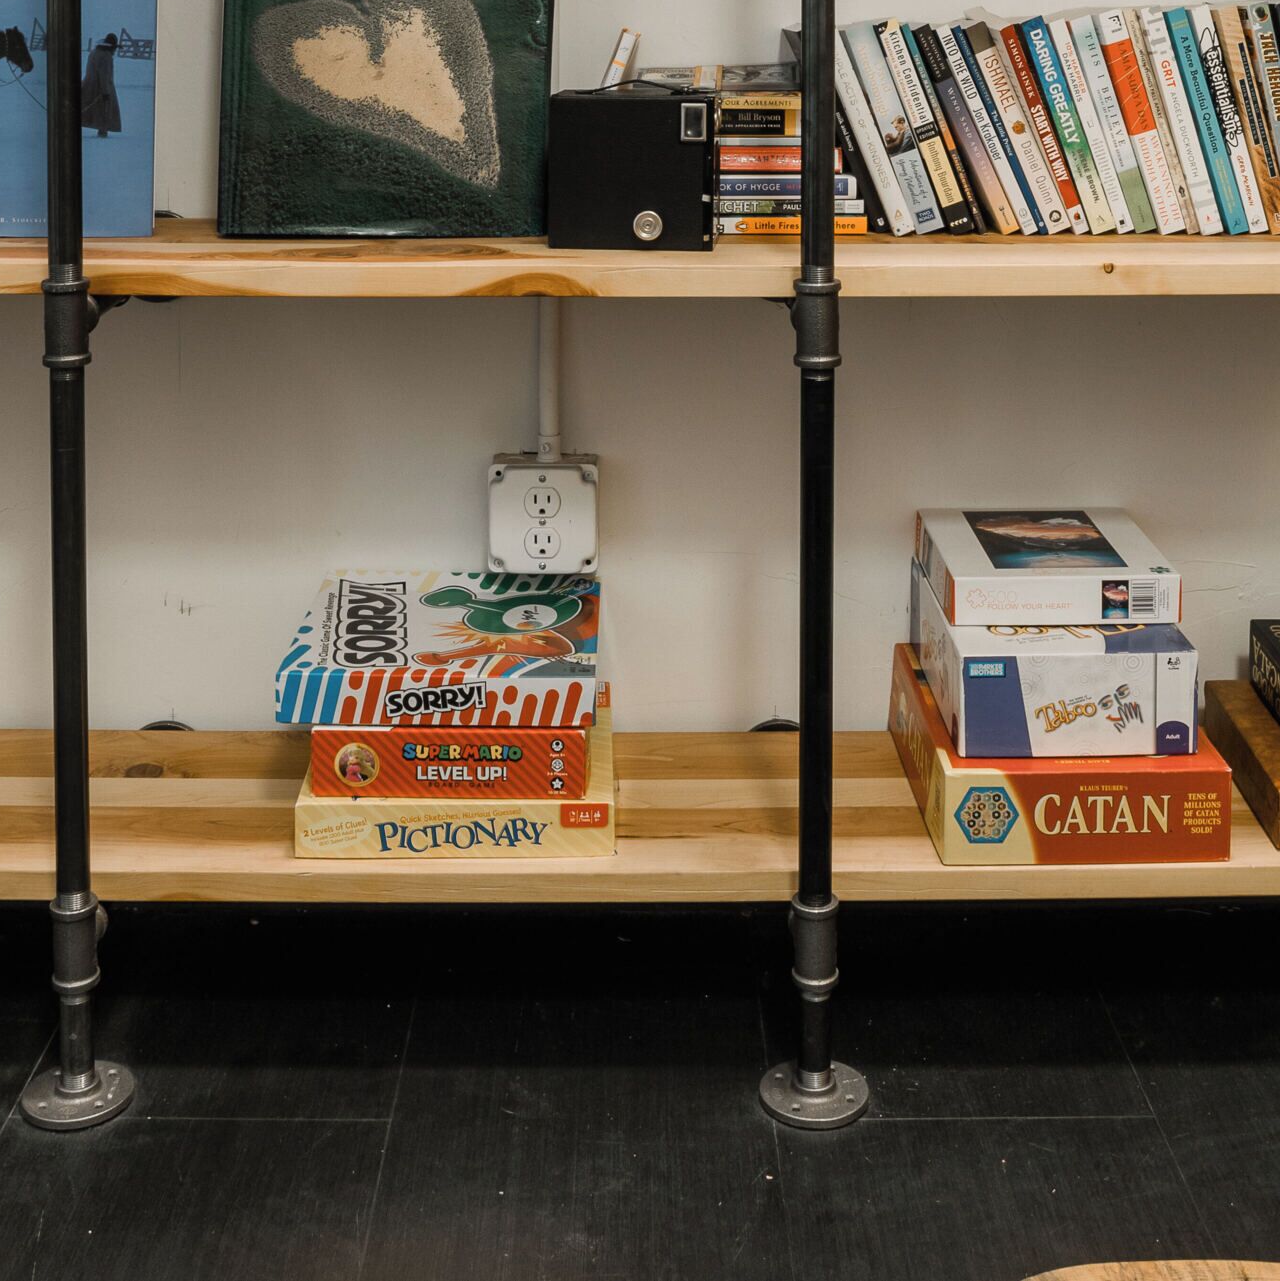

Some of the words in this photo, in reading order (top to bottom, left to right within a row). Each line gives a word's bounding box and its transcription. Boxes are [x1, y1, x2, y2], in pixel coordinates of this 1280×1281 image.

[942, 34, 959, 57] INTO
[1180, 35, 1189, 43] A
[952, 57, 968, 76] THE
[1008, 38, 1025, 69] SIMON
[1020, 70, 1036, 98] SINEK
[1183, 45, 1194, 68] More
[889, 31, 907, 66] Kitchen
[902, 67, 930, 124] Confidential
[959, 75, 978, 100] WILD
[983, 53, 1017, 114] ISHMAEL
[1029, 28, 1058, 82] DARING
[1049, 83, 1081, 143] GREATLY
[1190, 70, 1208, 110] Beautiful
[1206, 51, 1238, 134] essentialism
[738, 113, 751, 121] Bill
[753, 113, 781, 122] Bryson
[972, 107, 986, 122] Jon
[1161, 59, 1177, 88] GRIT
[1170, 91, 1185, 127] ANGELA
[1180, 126, 1199, 178] DUCKWORTH
[980, 122, 1002, 161] Krakauer
[1030, 104, 1050, 134] START
[1041, 134, 1061, 160] WITH
[1051, 158, 1069, 182] WHY
[1202, 112, 1218, 154] Question
[927, 141, 942, 172] Anthony
[939, 170, 956, 203] Bourdain
[1020, 140, 1042, 173] Daniel
[1035, 174, 1054, 205] Quinn
[1138, 137, 1159, 181] BUDDHA
[1152, 184, 1169, 226] WITHIN
[754, 221, 776, 231] Little
[778, 221, 799, 230] Fires
[987, 603, 1019, 611] FOLLOW
[343, 584, 399, 665] SORRY!
[387, 684, 485, 716] SORRY!
[1035, 700, 1098, 732] Taboo
[403, 743, 461, 761] SUPER
[462, 744, 522, 762] MARIO
[417, 765, 473, 781] LEVEL
[477, 765, 507, 781] UP!
[1183, 801, 1221, 809] MILLIONS
[1187, 793, 1203, 801] TENS
[1206, 793, 1218, 801] OF
[303, 830, 309, 838] 2
[310, 825, 335, 837] Levels
[336, 823, 345, 833] of
[345, 819, 369, 831] Clues!
[1033, 793, 1171, 836] CATAN
[1191, 826, 1213, 834] SOLD!
[374, 817, 550, 853] PICTIONARY
